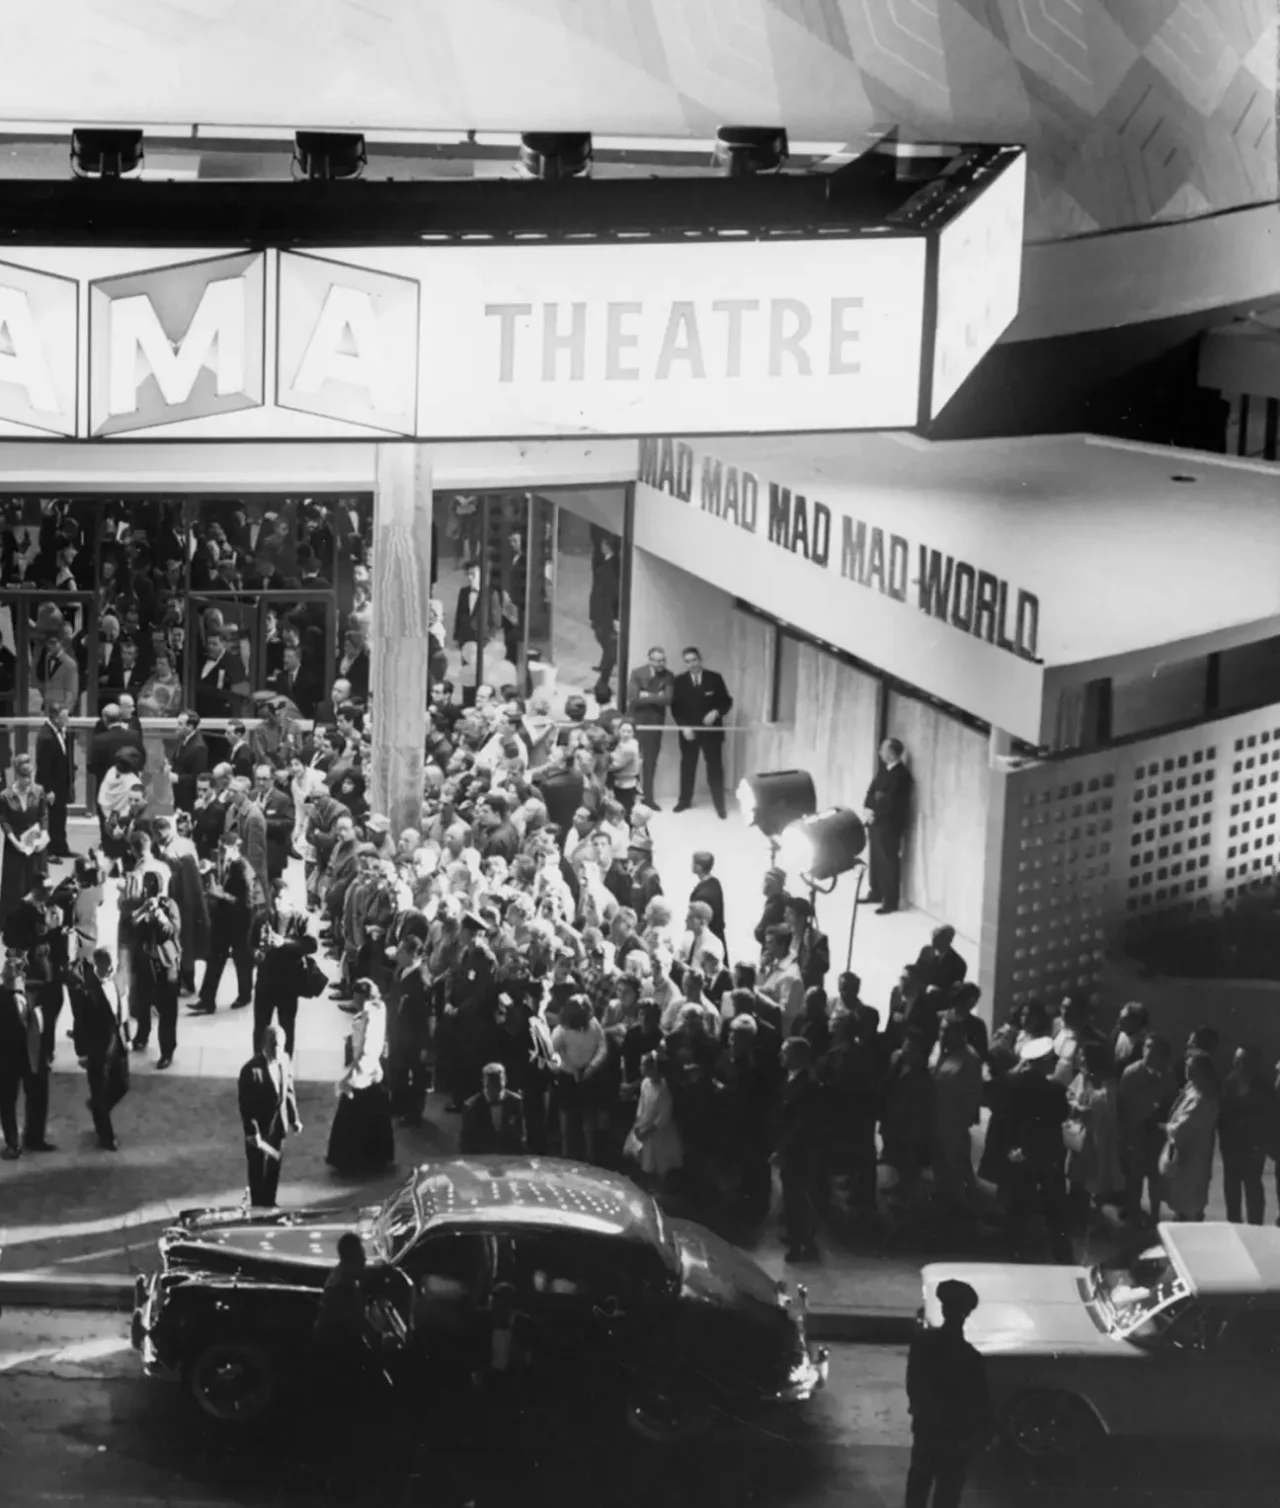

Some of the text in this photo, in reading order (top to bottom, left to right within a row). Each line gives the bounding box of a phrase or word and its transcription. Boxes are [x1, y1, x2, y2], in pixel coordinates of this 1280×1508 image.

[484, 296, 865, 383] THEATRE
[637, 437, 1040, 664] MAD MAD MAD MAD WORLD
